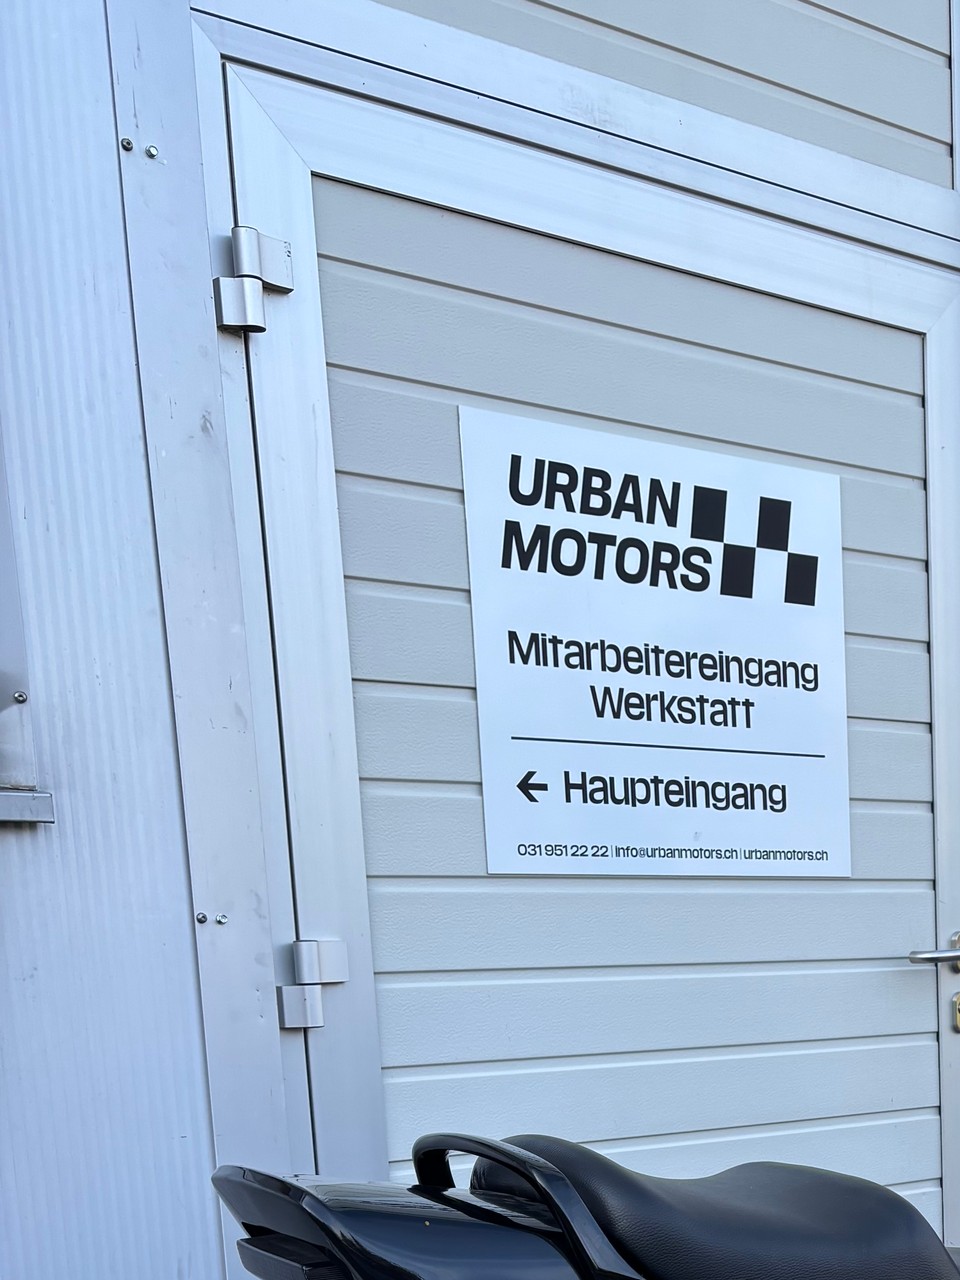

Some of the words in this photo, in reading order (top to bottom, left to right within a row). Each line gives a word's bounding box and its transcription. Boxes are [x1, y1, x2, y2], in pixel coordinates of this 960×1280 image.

[508, 454, 681, 528] URBAN
[501, 520, 713, 592] MOTORS
[507, 630, 819, 692] Mitarbeitereingang
[590, 686, 756, 729] Werkstatt
[563, 770, 788, 813] Haupteingang
